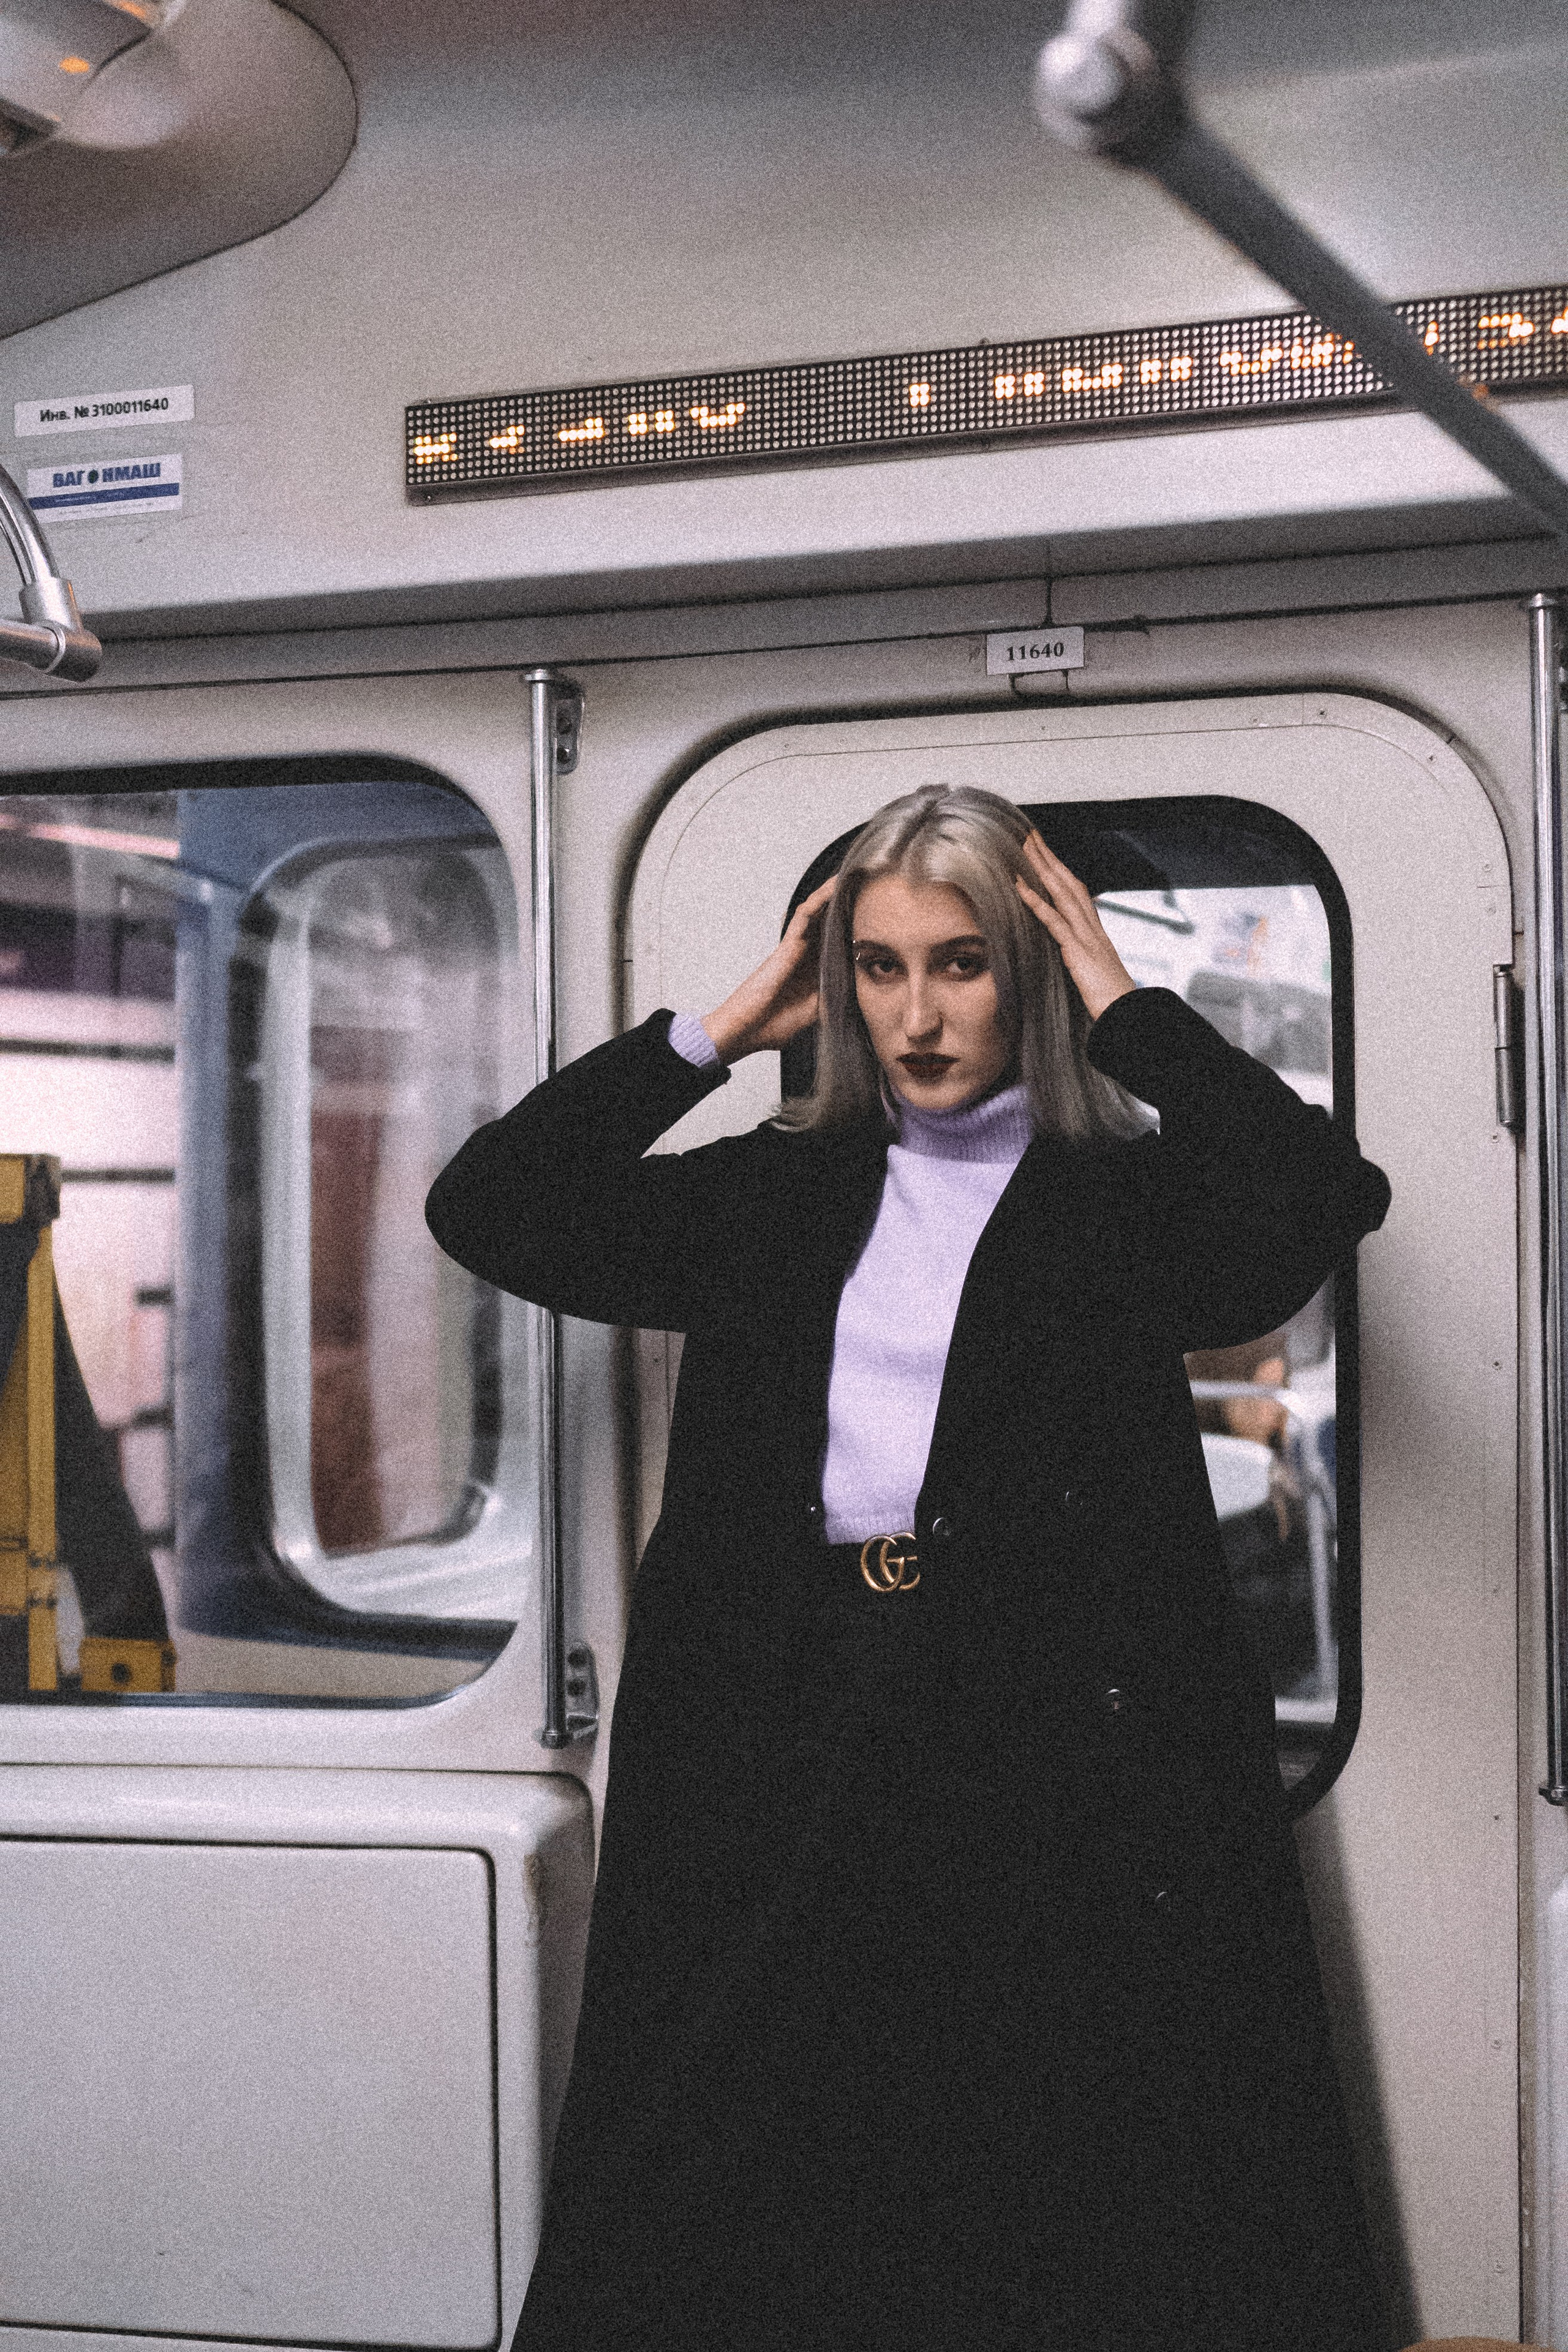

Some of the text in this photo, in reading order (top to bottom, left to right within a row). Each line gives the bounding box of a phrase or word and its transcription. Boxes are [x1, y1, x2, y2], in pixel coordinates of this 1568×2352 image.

[40, 398, 169, 422] Инв. № 3100011640
[1006, 642, 1065, 662] 11640
